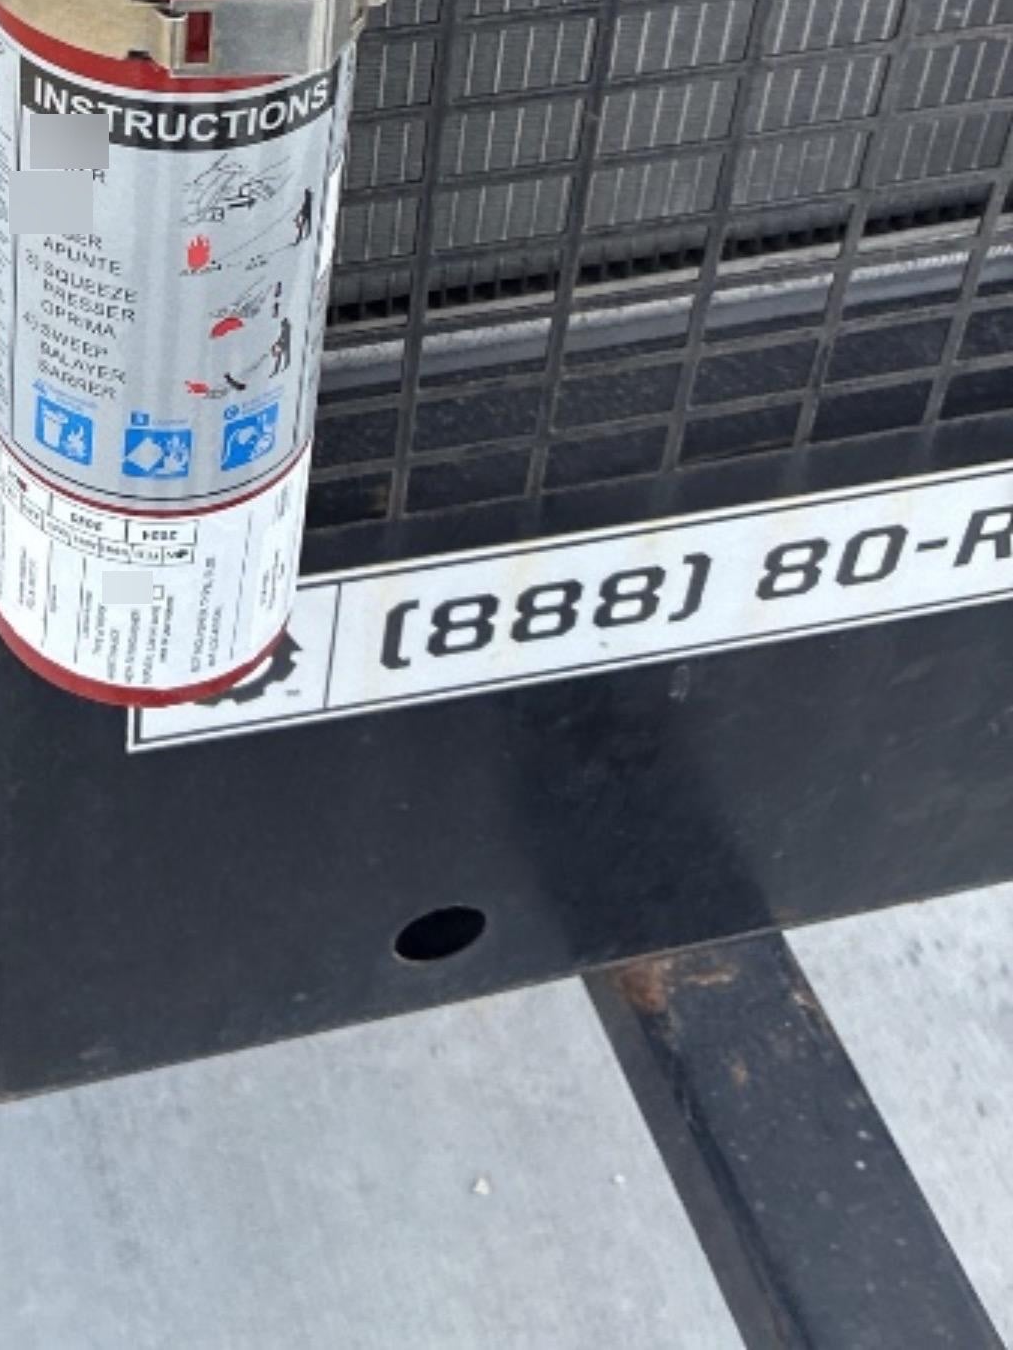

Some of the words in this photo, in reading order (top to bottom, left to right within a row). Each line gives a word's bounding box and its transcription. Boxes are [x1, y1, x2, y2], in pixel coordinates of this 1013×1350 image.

[33, 75, 329, 142] INSTRUCTIONS
[43, 261, 139, 305] SQUEEZE
[380, 552, 713, 670] (888)
